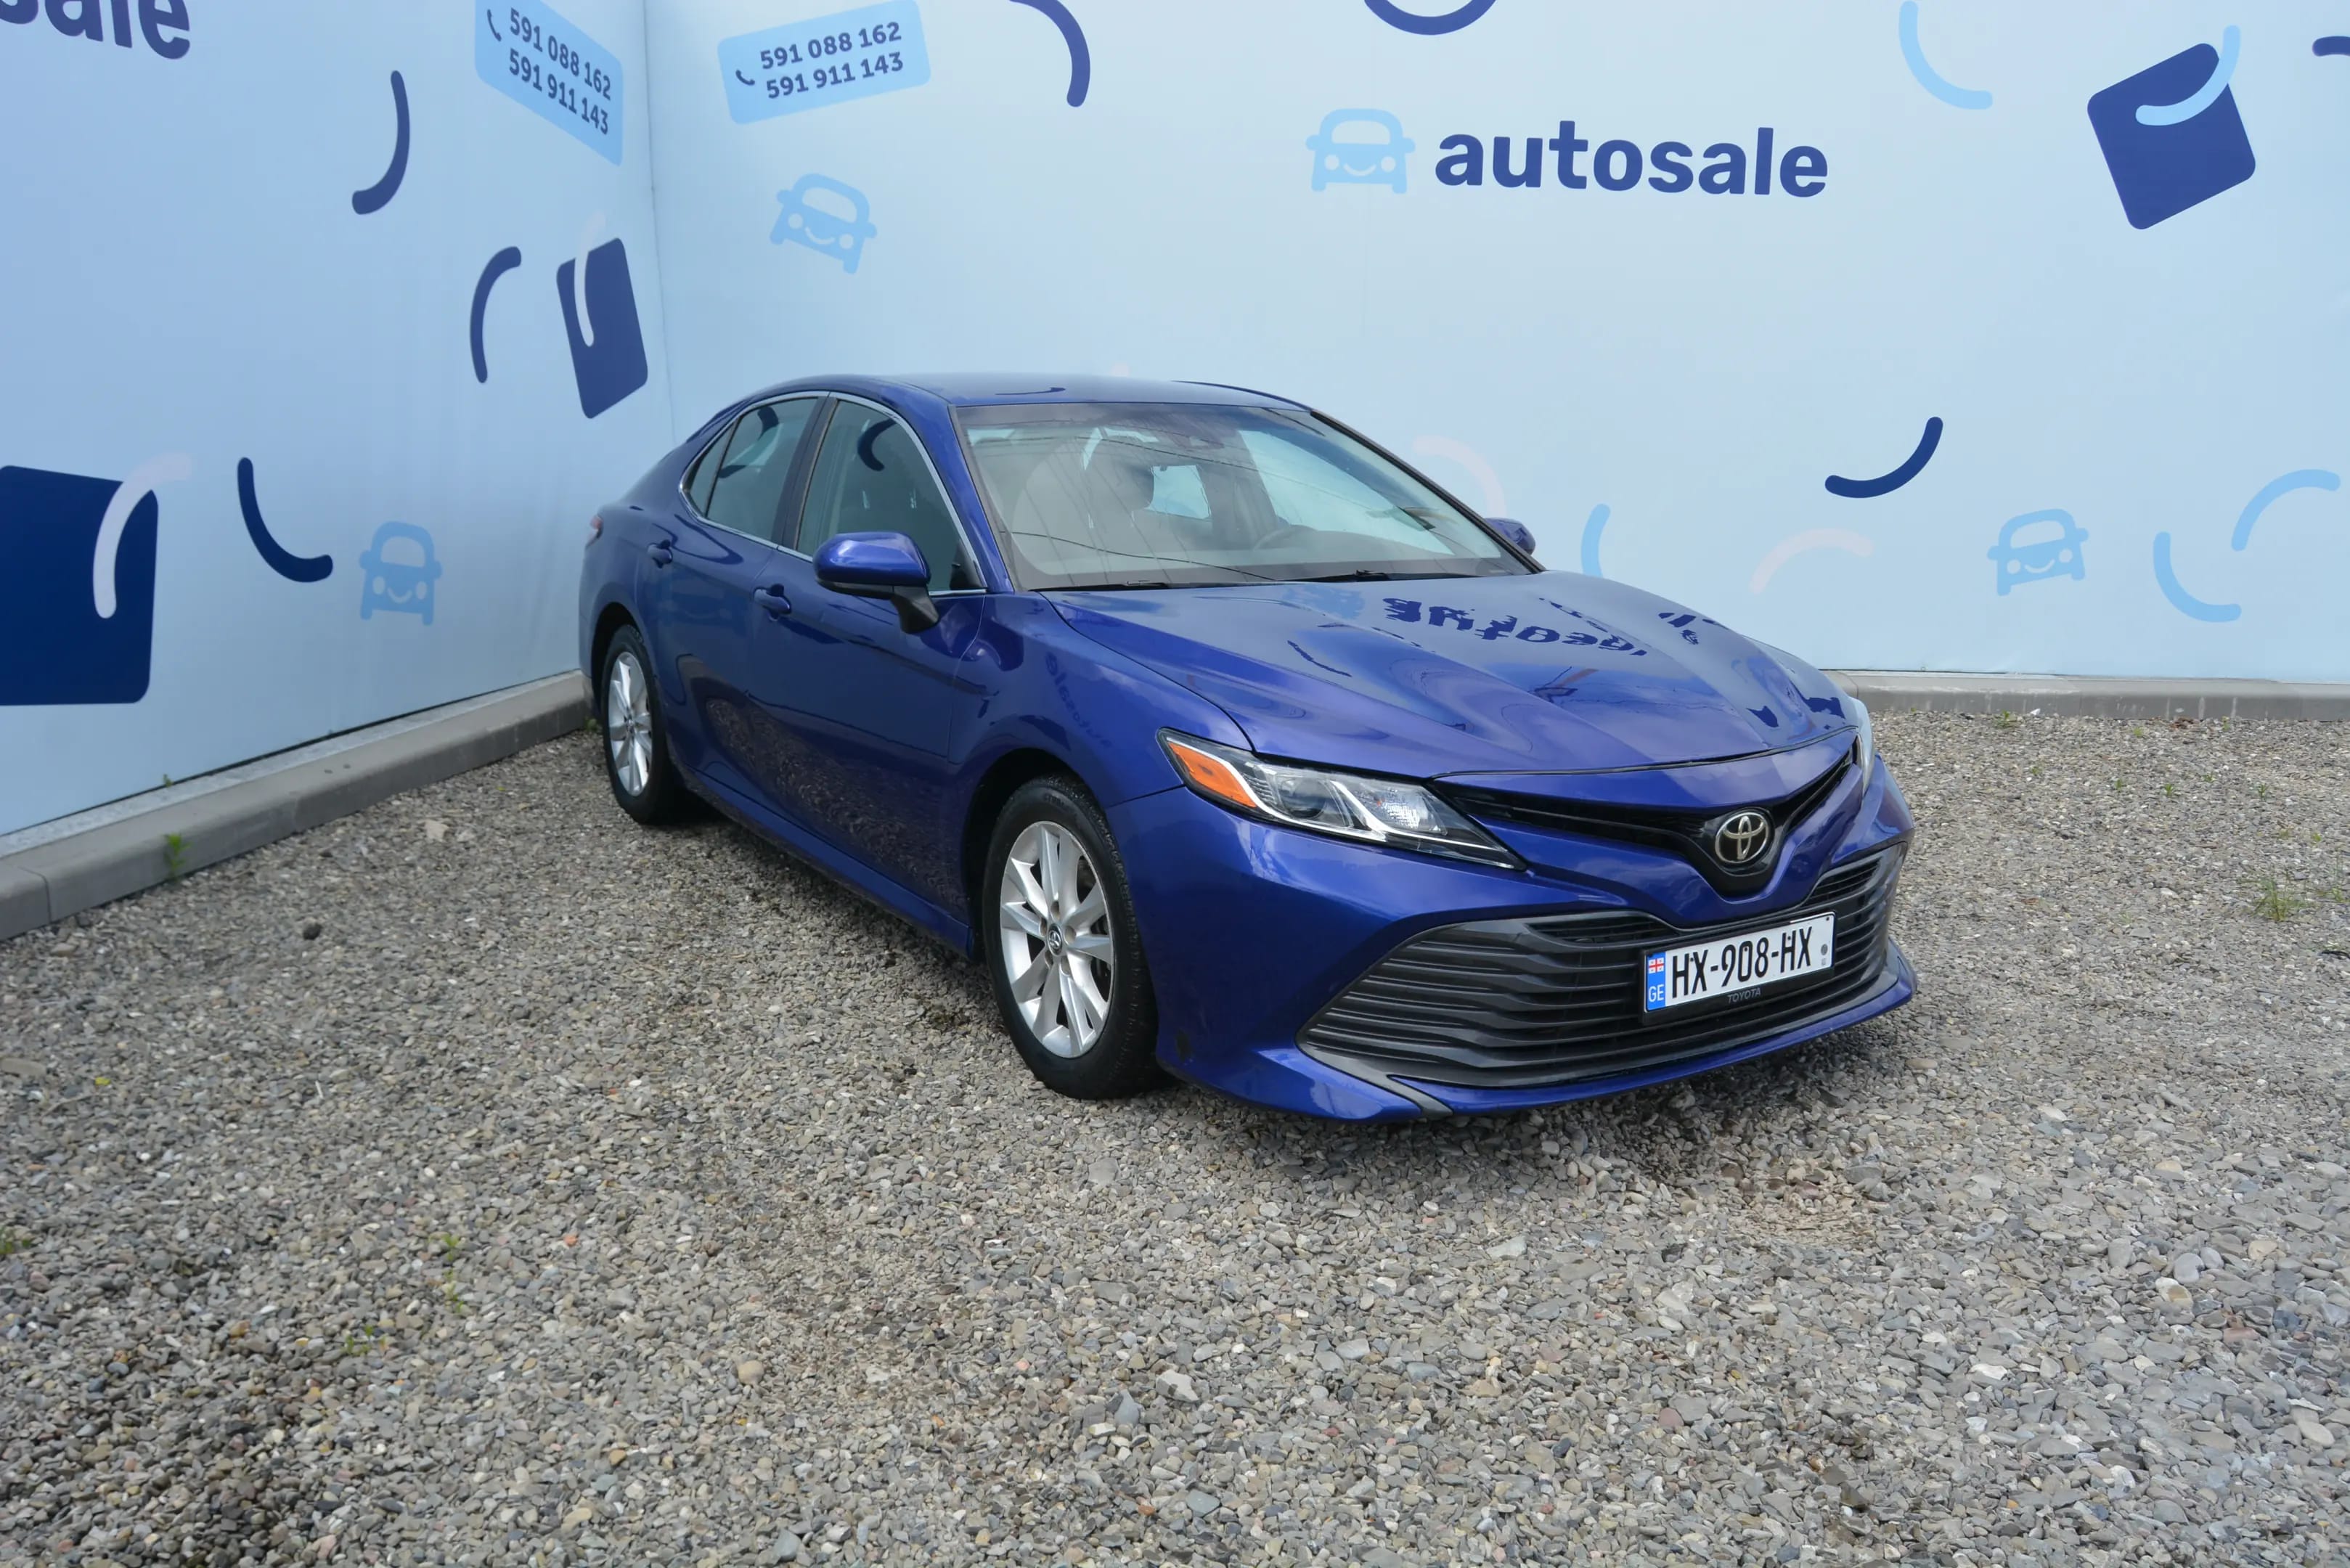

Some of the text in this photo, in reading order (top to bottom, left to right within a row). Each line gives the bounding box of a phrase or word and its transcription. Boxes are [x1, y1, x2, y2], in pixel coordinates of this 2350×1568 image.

[0, 0, 190, 60] ale
[510, 7, 611, 101] 591 088 162
[760, 22, 902, 70] 591 088 162
[510, 48, 608, 135] 591 911 143
[766, 52, 903, 99] 591 911 143
[1435, 120, 1828, 197] autosale
[1672, 926, 1812, 999] HX-908-HX
[1649, 984, 1665, 1003] GE
[1727, 987, 1761, 1003] TOYOTA
